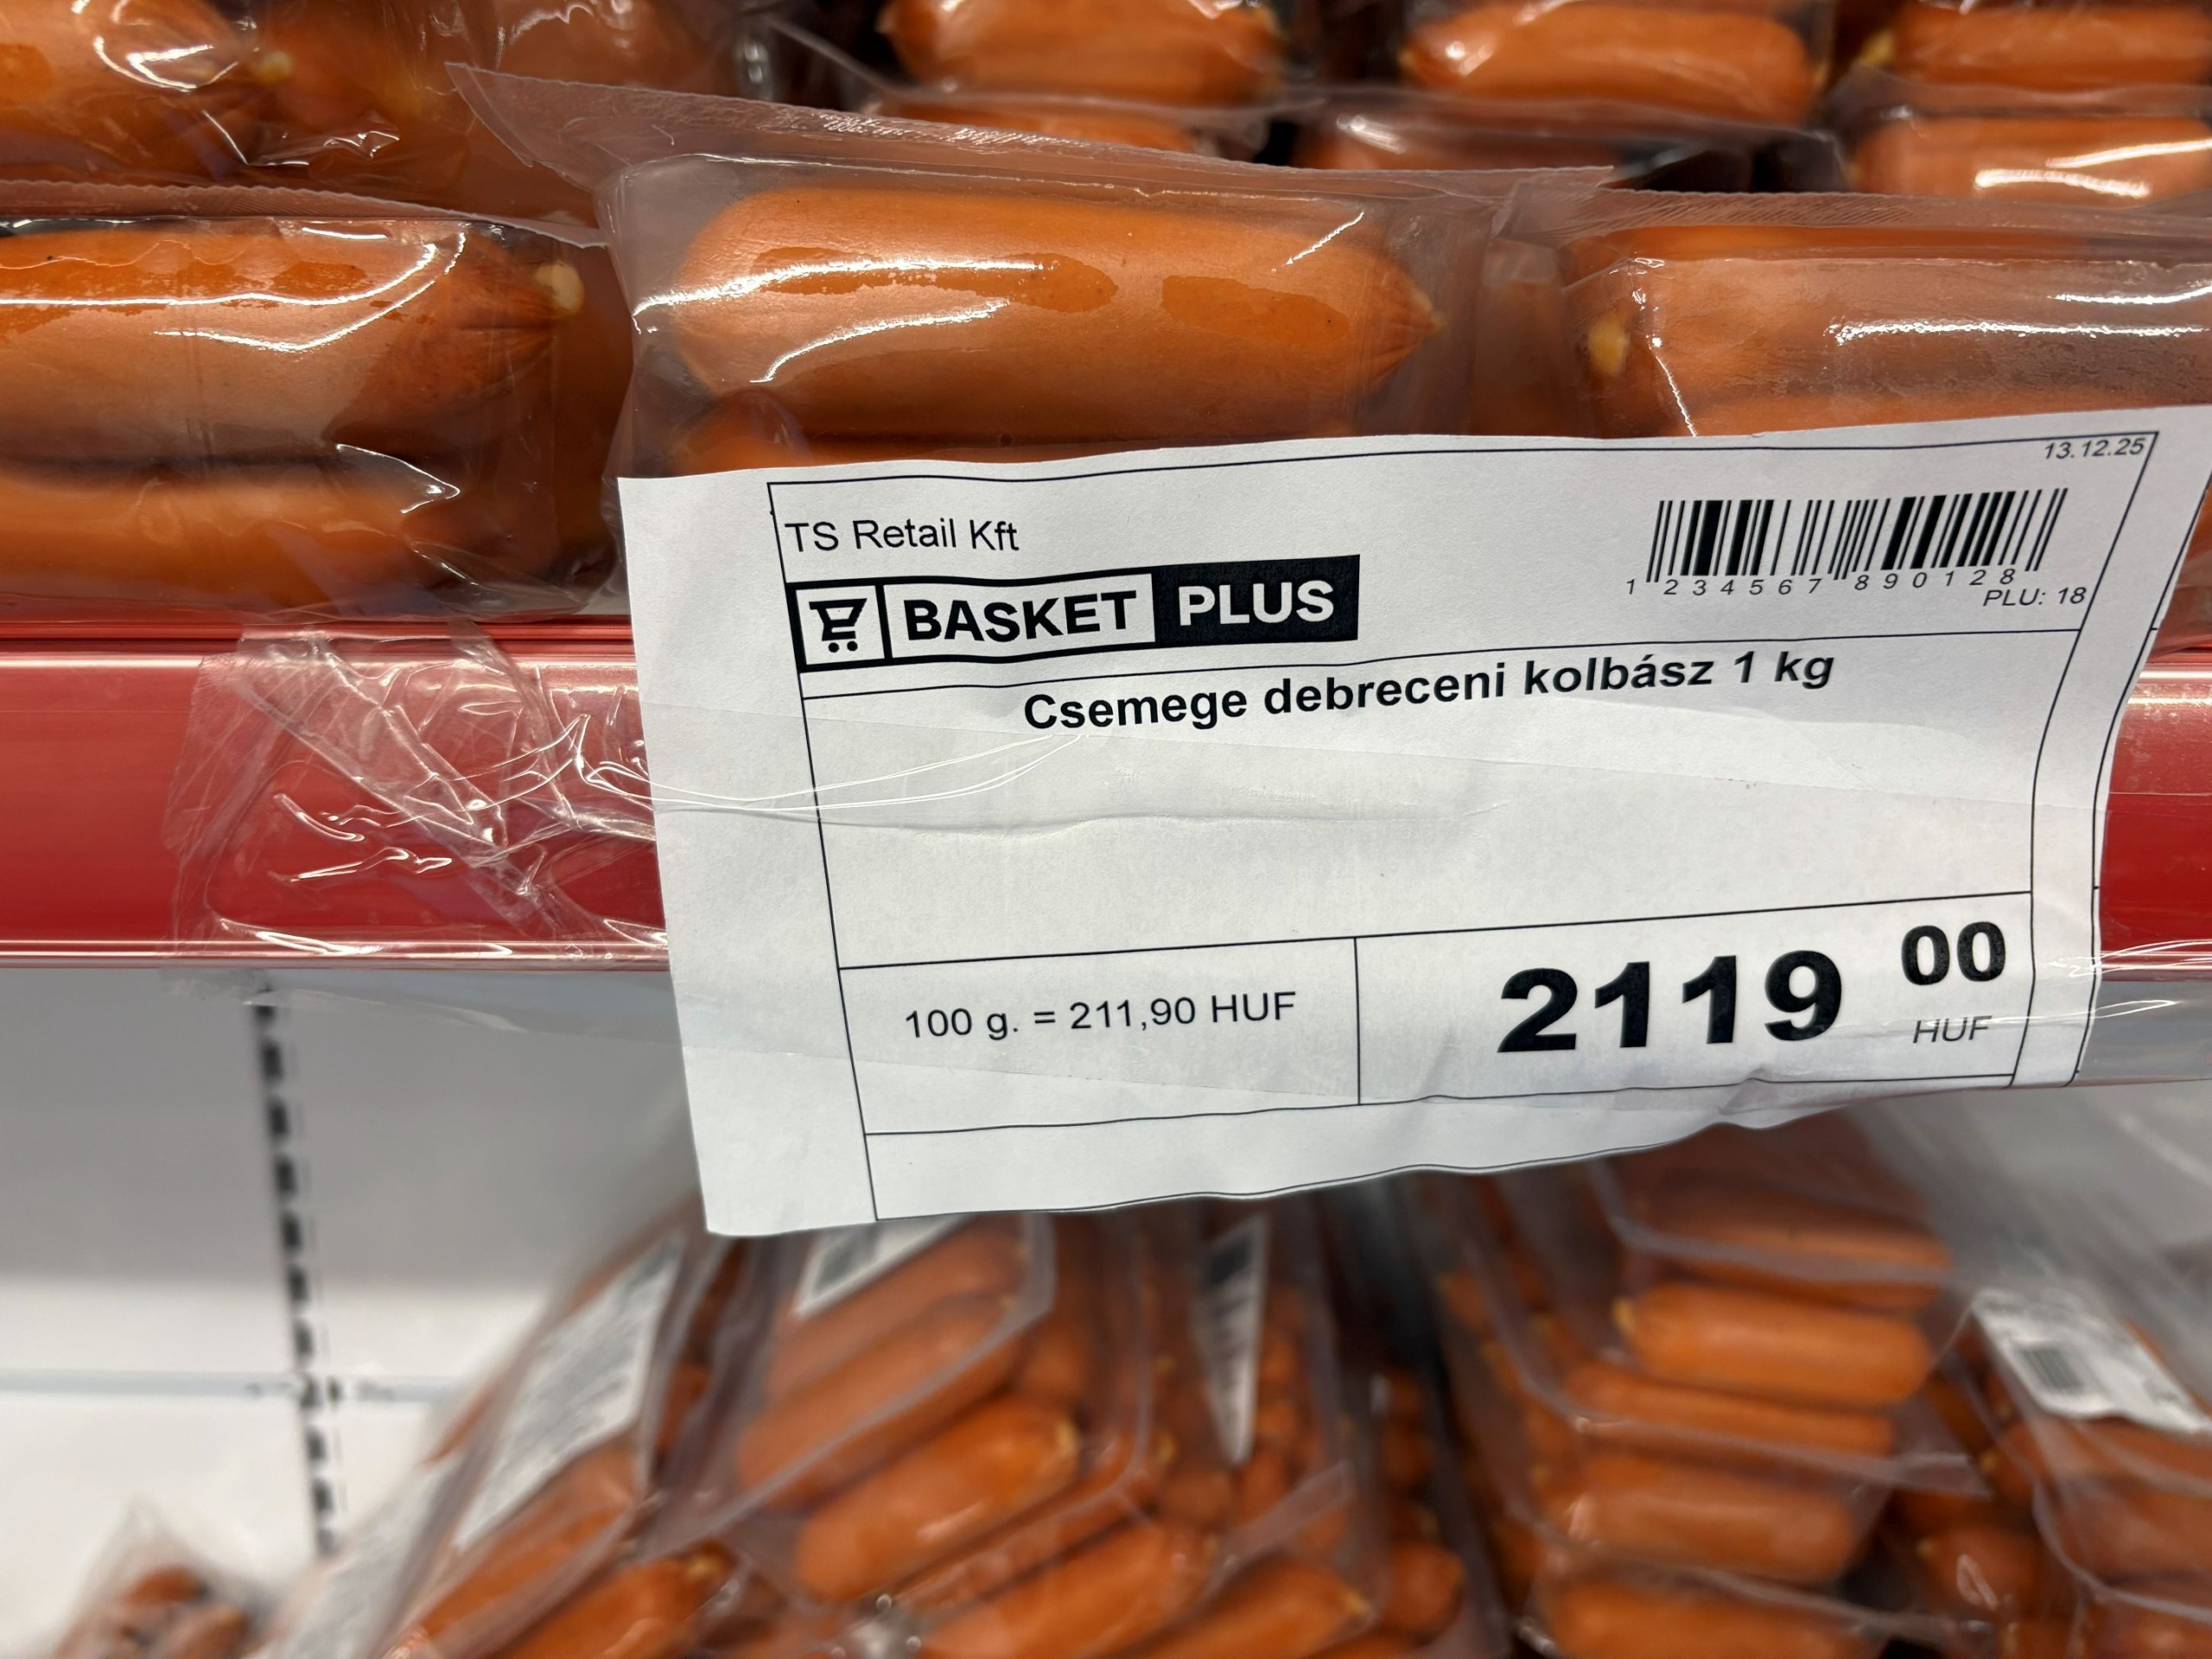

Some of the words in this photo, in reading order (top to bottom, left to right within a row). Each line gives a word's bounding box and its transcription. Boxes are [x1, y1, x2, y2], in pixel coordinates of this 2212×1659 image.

[2043, 437, 2145, 461] 13.12.25
[785, 521, 840, 552] TS
[853, 518, 957, 550] Retail
[969, 518, 1020, 551] Kft
[904, 590, 1138, 643] BASKET
[1178, 580, 1334, 626] PLUS
[1983, 588, 2048, 607] PLU:
[2056, 587, 2088, 606] 18
[1023, 688, 1248, 730] Csemege
[1263, 662, 1506, 715] debreceni
[1524, 650, 1714, 695] kolbász
[1734, 651, 1756, 683] 1
[1774, 651, 1835, 690] kg
[1496, 950, 1843, 1054] 2119
[1900, 920, 2007, 986] 00
[906, 1007, 973, 1039] 100
[986, 1013, 1019, 1041] g.
[1033, 1010, 1057, 1025] =
[1069, 996, 1196, 1032] 211,90
[1211, 990, 1297, 1023] HUF
[1911, 1014, 1993, 1044] HUF
